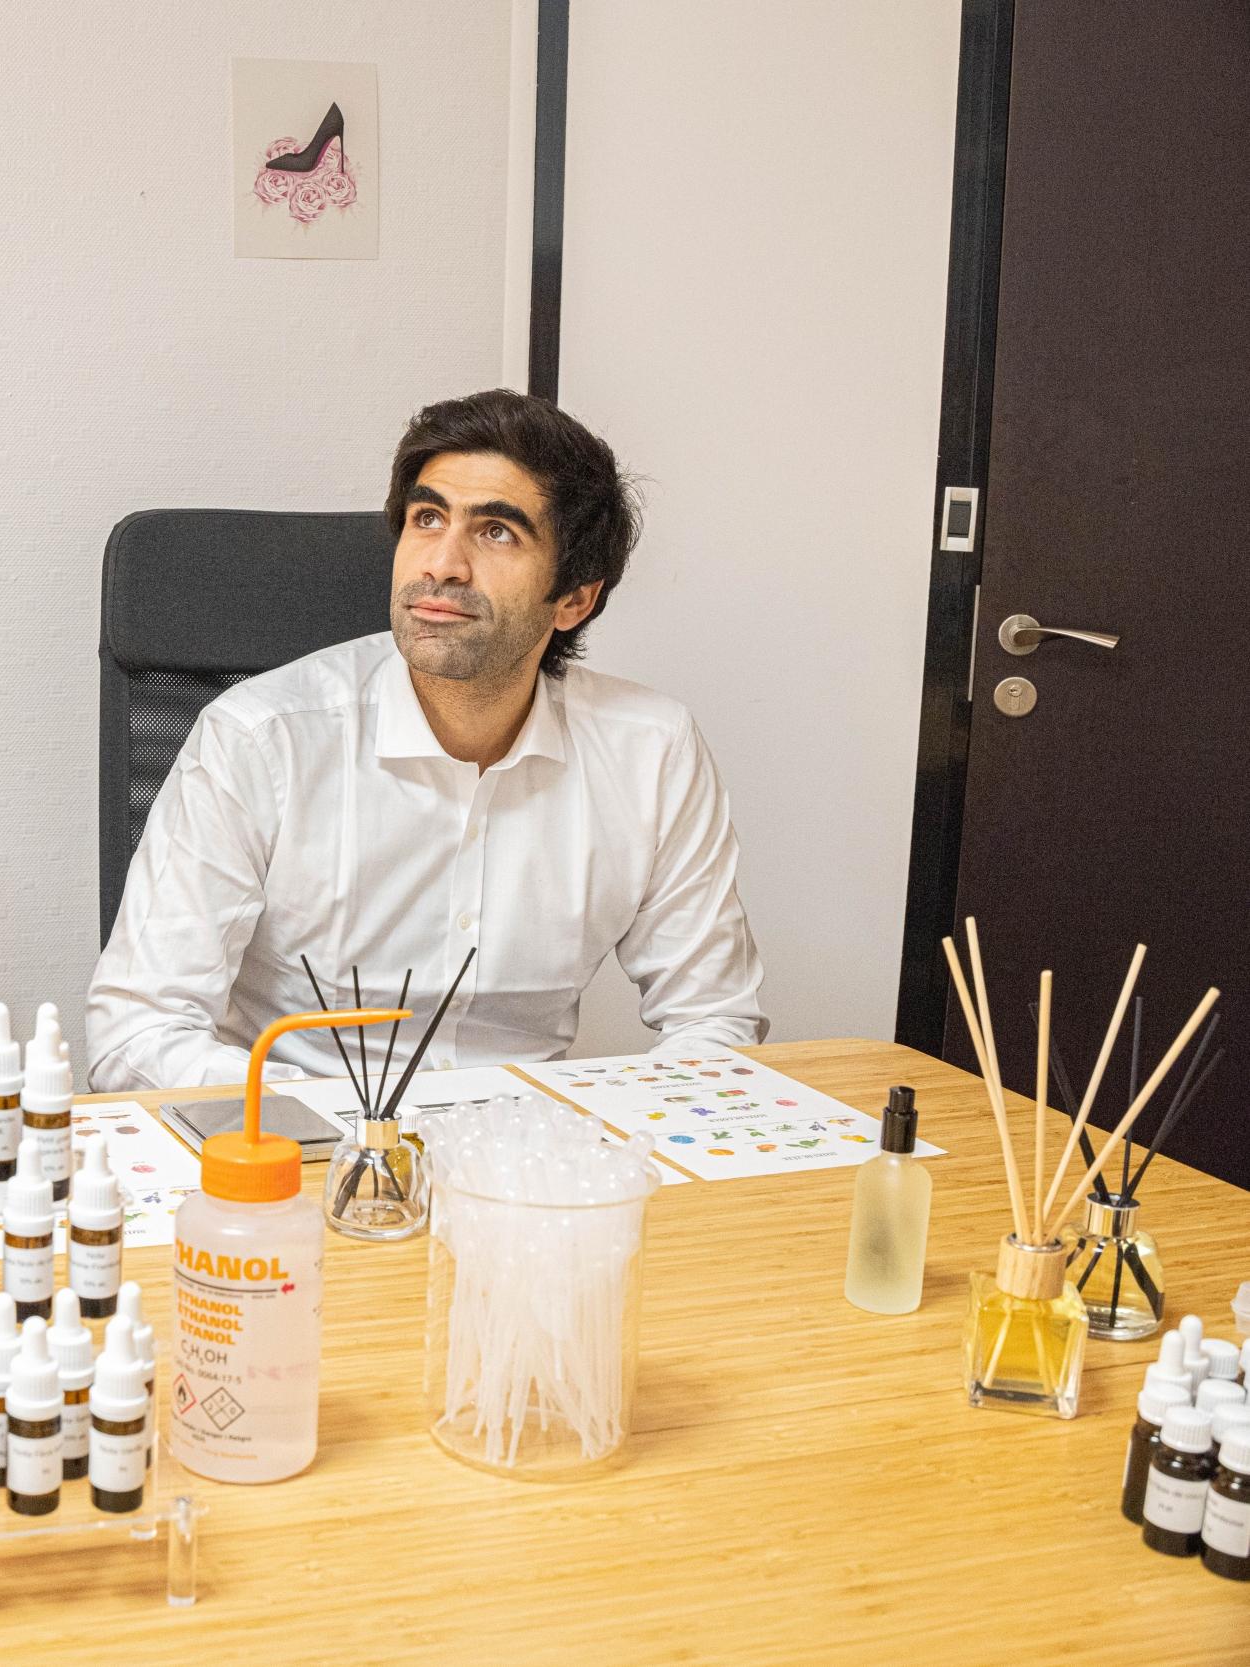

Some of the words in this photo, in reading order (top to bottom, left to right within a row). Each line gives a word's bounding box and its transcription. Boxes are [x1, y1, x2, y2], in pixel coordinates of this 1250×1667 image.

[175, 1237, 289, 1281] HANOL
[177, 1287, 244, 1316] ETHANOL
[180, 1319, 236, 1345] ETANOL
